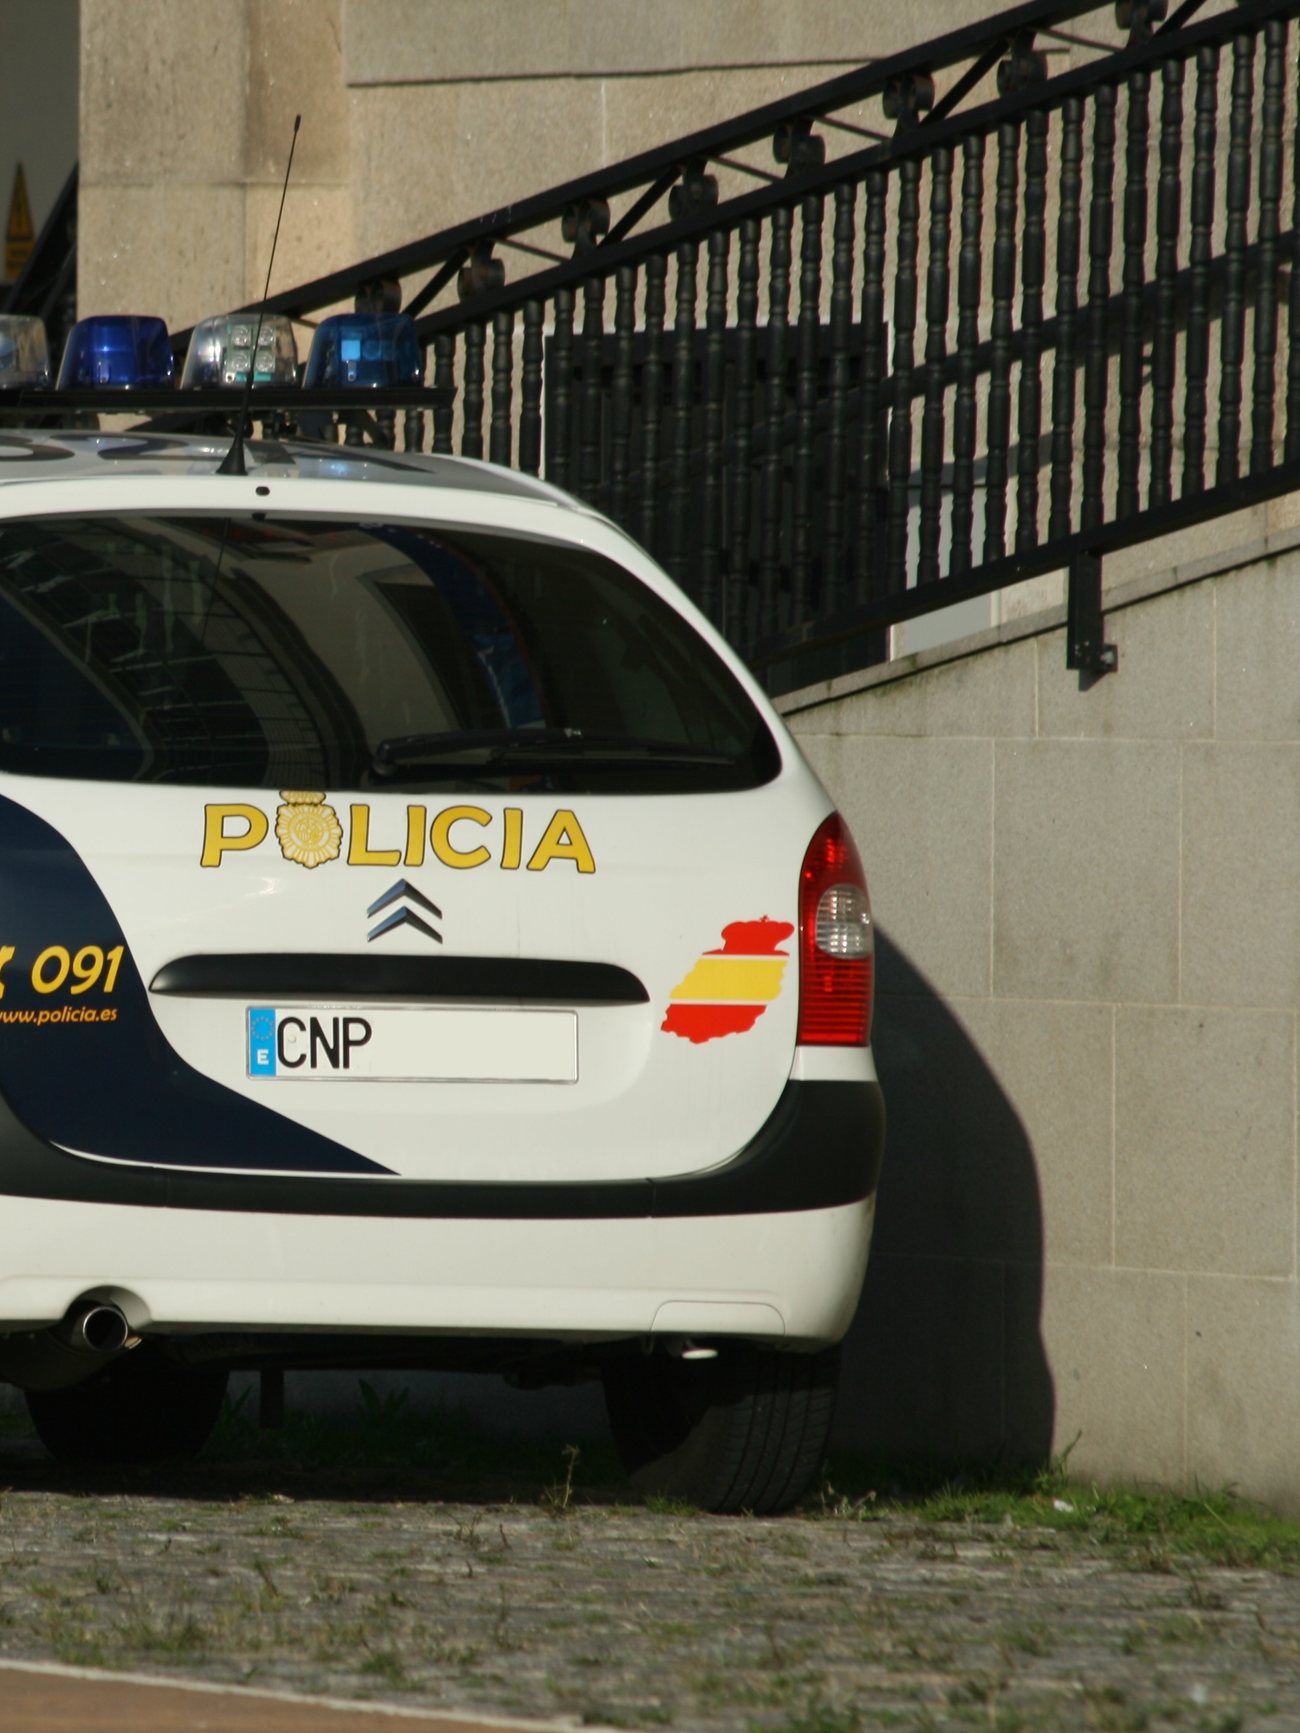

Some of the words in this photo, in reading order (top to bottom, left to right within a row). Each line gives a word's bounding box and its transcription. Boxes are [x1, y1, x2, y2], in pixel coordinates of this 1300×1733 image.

[31, 944, 125, 995] 091
[256, 1048, 270, 1065] E
[276, 1015, 373, 1070] CNP
